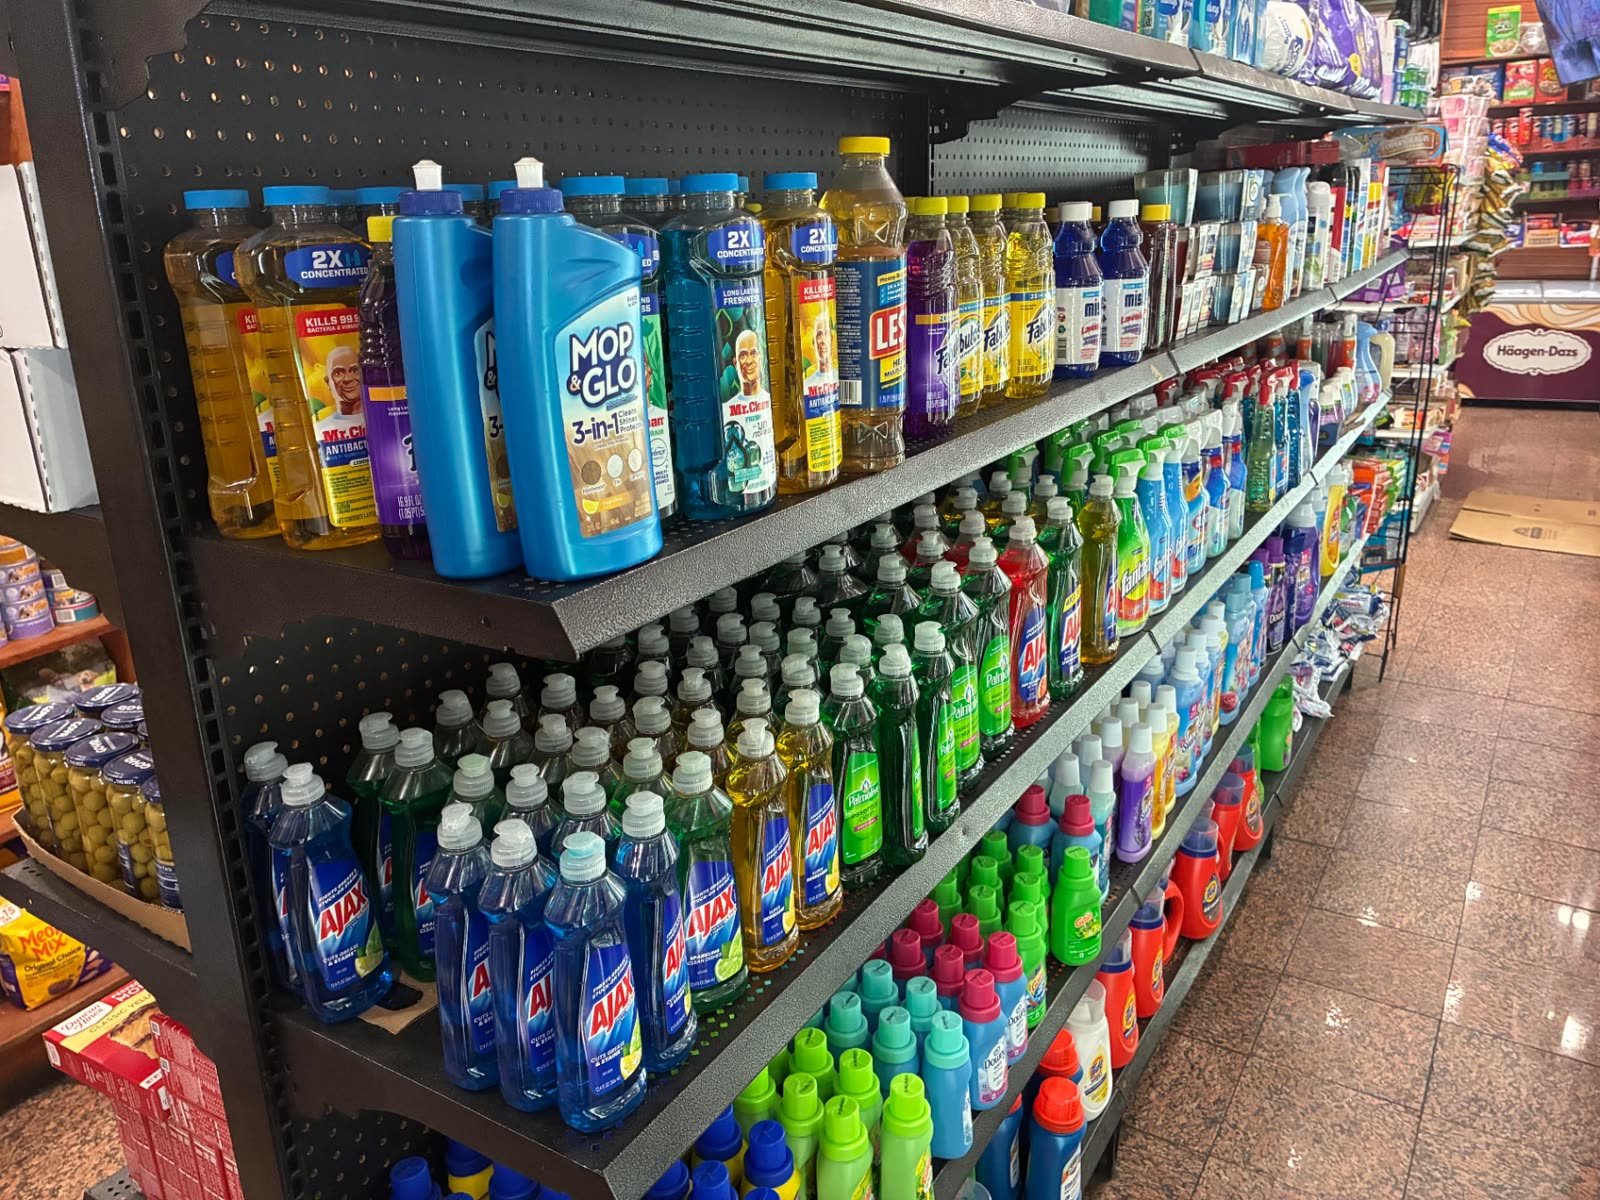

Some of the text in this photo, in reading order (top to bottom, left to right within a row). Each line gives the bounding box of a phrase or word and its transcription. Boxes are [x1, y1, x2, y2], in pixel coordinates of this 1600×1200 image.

[728, 231, 750, 248] 2X
[809, 228, 827, 244] 2X
[312, 250, 343, 269] 2X
[305, 315, 337, 327] KILLS
[571, 323, 633, 371] MOP
[1497, 345, 1578, 359] Häagen-Dazs
[572, 412, 620, 446] 3-in-1
[808, 810, 836, 855] AJAX
[319, 887, 337, 902] FIGHTS
[321, 880, 368, 940] AJAX
[688, 884, 734, 938] AJAX
[24, 958, 55, 973] Original
[591, 967, 633, 1037] AJAX
[65, 1004, 100, 1031] Duncan
[75, 1007, 104, 1030] Hines
[89, 1008, 127, 1033] CLASSIC
[591, 1053, 606, 1063] CUTS
